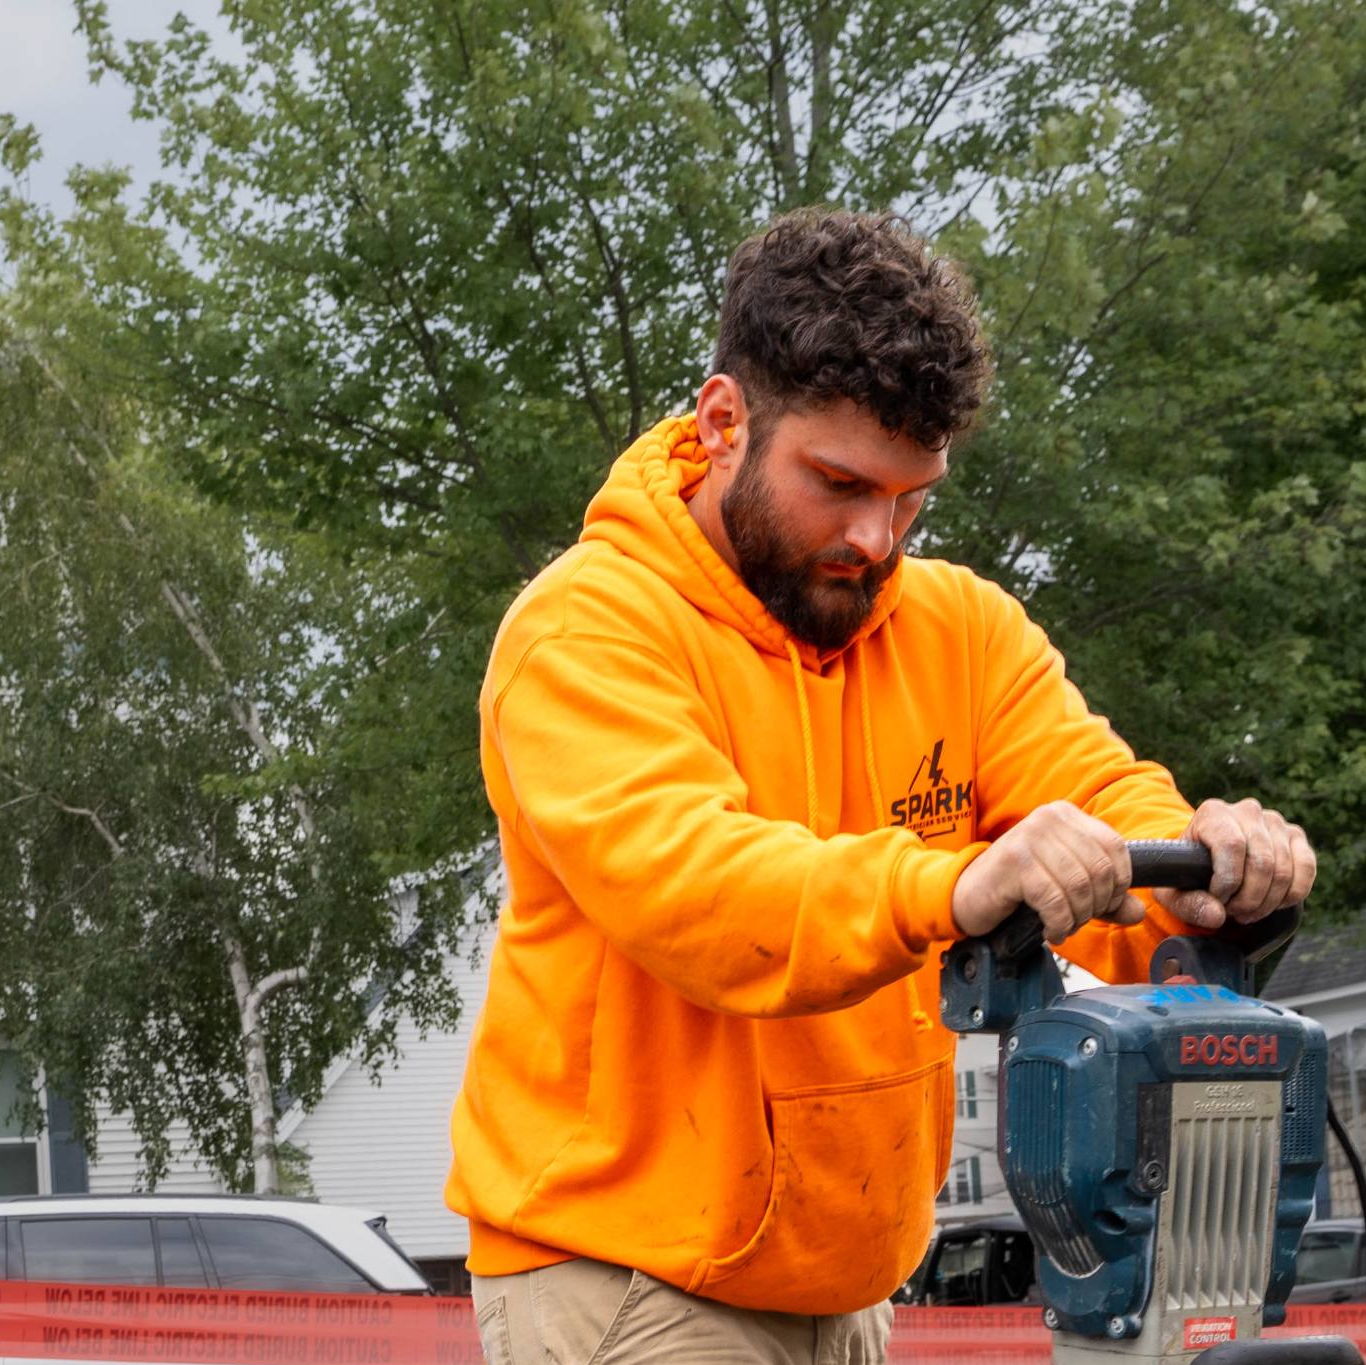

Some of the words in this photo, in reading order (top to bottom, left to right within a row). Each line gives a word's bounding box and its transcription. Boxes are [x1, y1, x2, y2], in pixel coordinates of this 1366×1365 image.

[891, 780, 972, 826] SPARK
[1180, 1034, 1278, 1066] BOSCH
[1194, 1100, 1255, 1113] Professional
[1189, 1333, 1230, 1344] CONTROL
